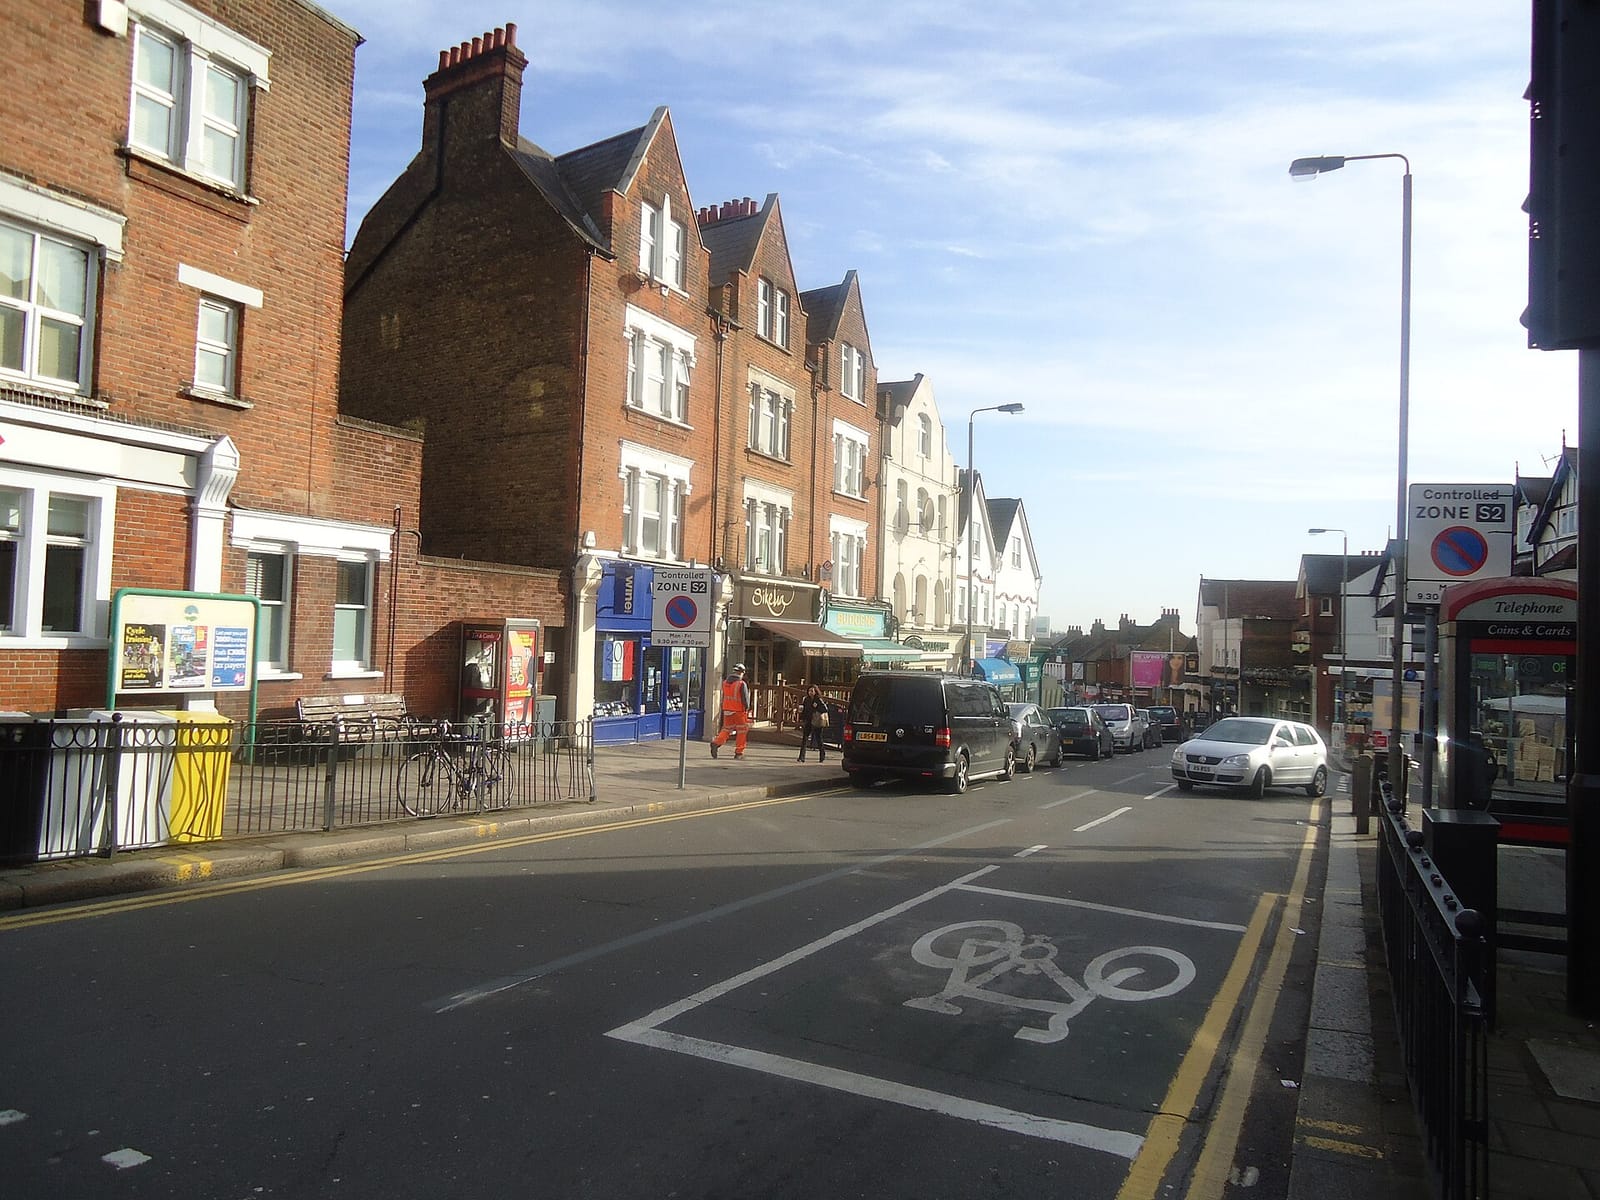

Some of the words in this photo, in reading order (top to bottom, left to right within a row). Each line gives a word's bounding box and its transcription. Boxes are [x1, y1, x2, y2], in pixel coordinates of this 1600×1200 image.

[1424, 489, 1499, 500] Controlled
[1416, 506, 1469, 519] ZONE
[1478, 505, 1503, 520] S2
[657, 582, 687, 592] ZONE
[691, 581, 706, 593] S2
[1417, 592, 1439, 600] 9.30
[1495, 601, 1563, 615] Telephone
[126, 626, 146, 636] Cycle
[1487, 625, 1519, 636] Coins
[1522, 625, 1534, 635] &
[1535, 625, 1571, 636] Cards
